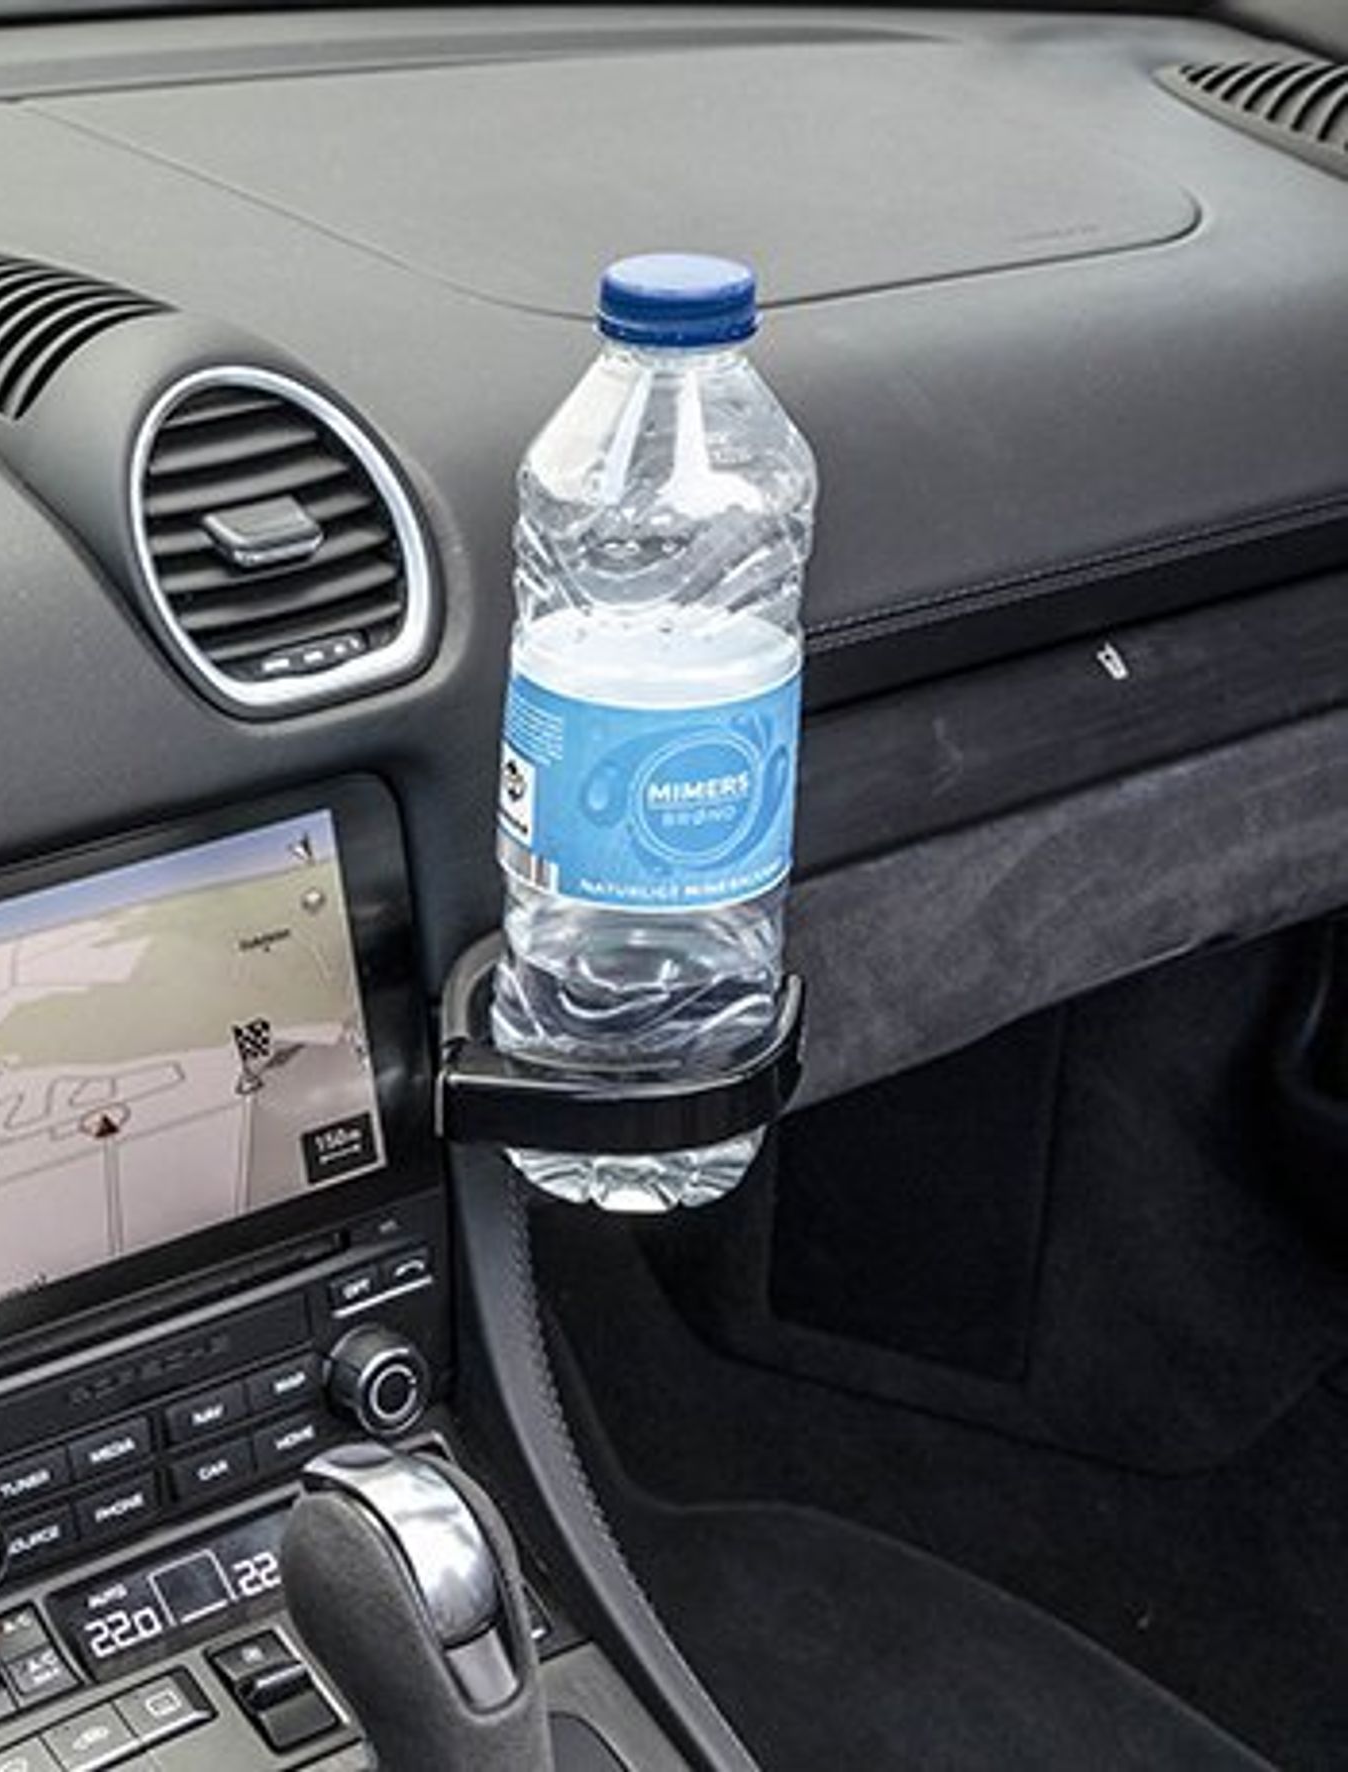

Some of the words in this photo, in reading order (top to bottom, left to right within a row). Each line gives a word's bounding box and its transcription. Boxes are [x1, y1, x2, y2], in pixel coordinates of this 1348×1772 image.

[89, 1436, 136, 1464] MEDIA
[0, 1467, 51, 1498] TUNER
[197, 1459, 229, 1482] CAR
[94, 1492, 145, 1524] PHONE
[7, 1524, 60, 1557] OURCE
